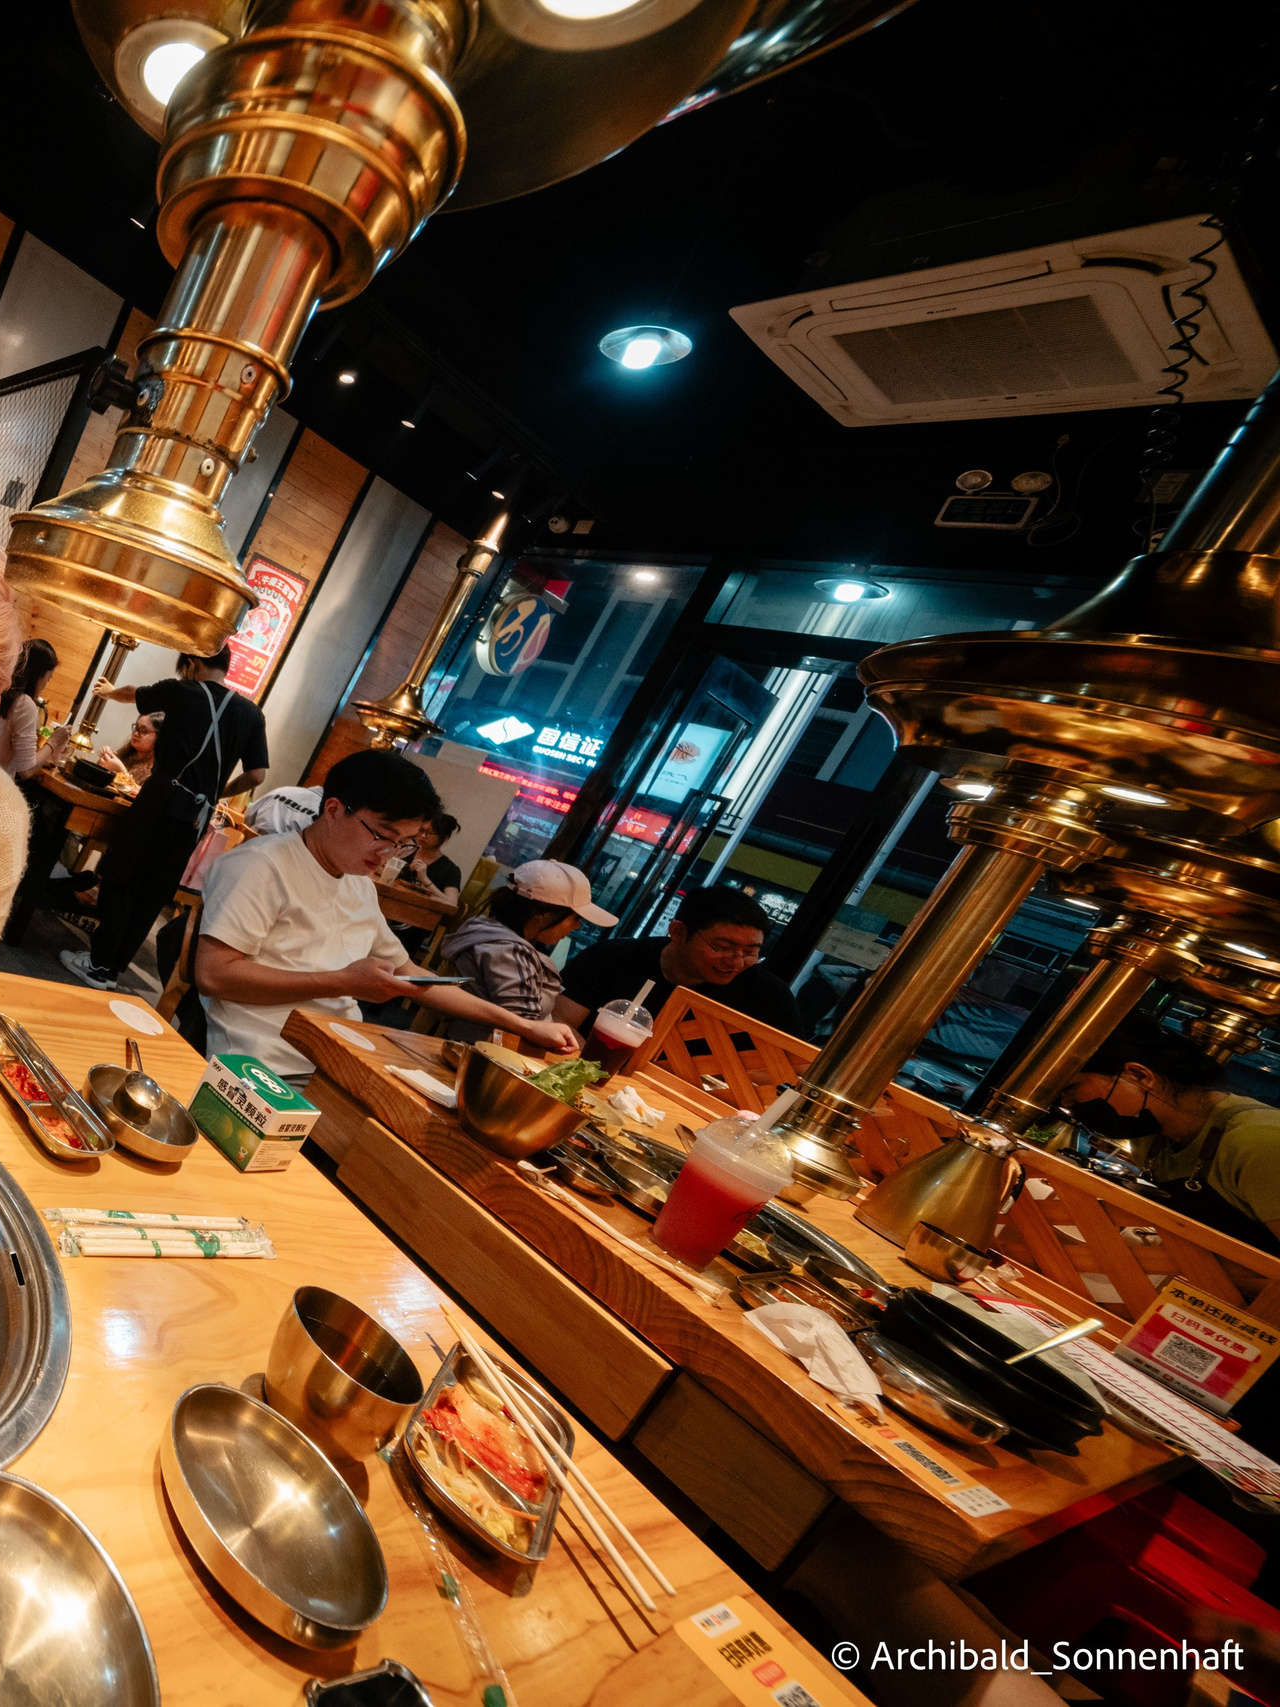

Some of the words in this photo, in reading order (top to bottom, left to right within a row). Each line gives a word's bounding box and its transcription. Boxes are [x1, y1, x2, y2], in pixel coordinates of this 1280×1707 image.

[217, 1079, 268, 1129] 感冒灵颗粒
[1170, 1287, 1279, 1346] 本单还能减钱
[1171, 1311, 1249, 1355] 扫码享优惠
